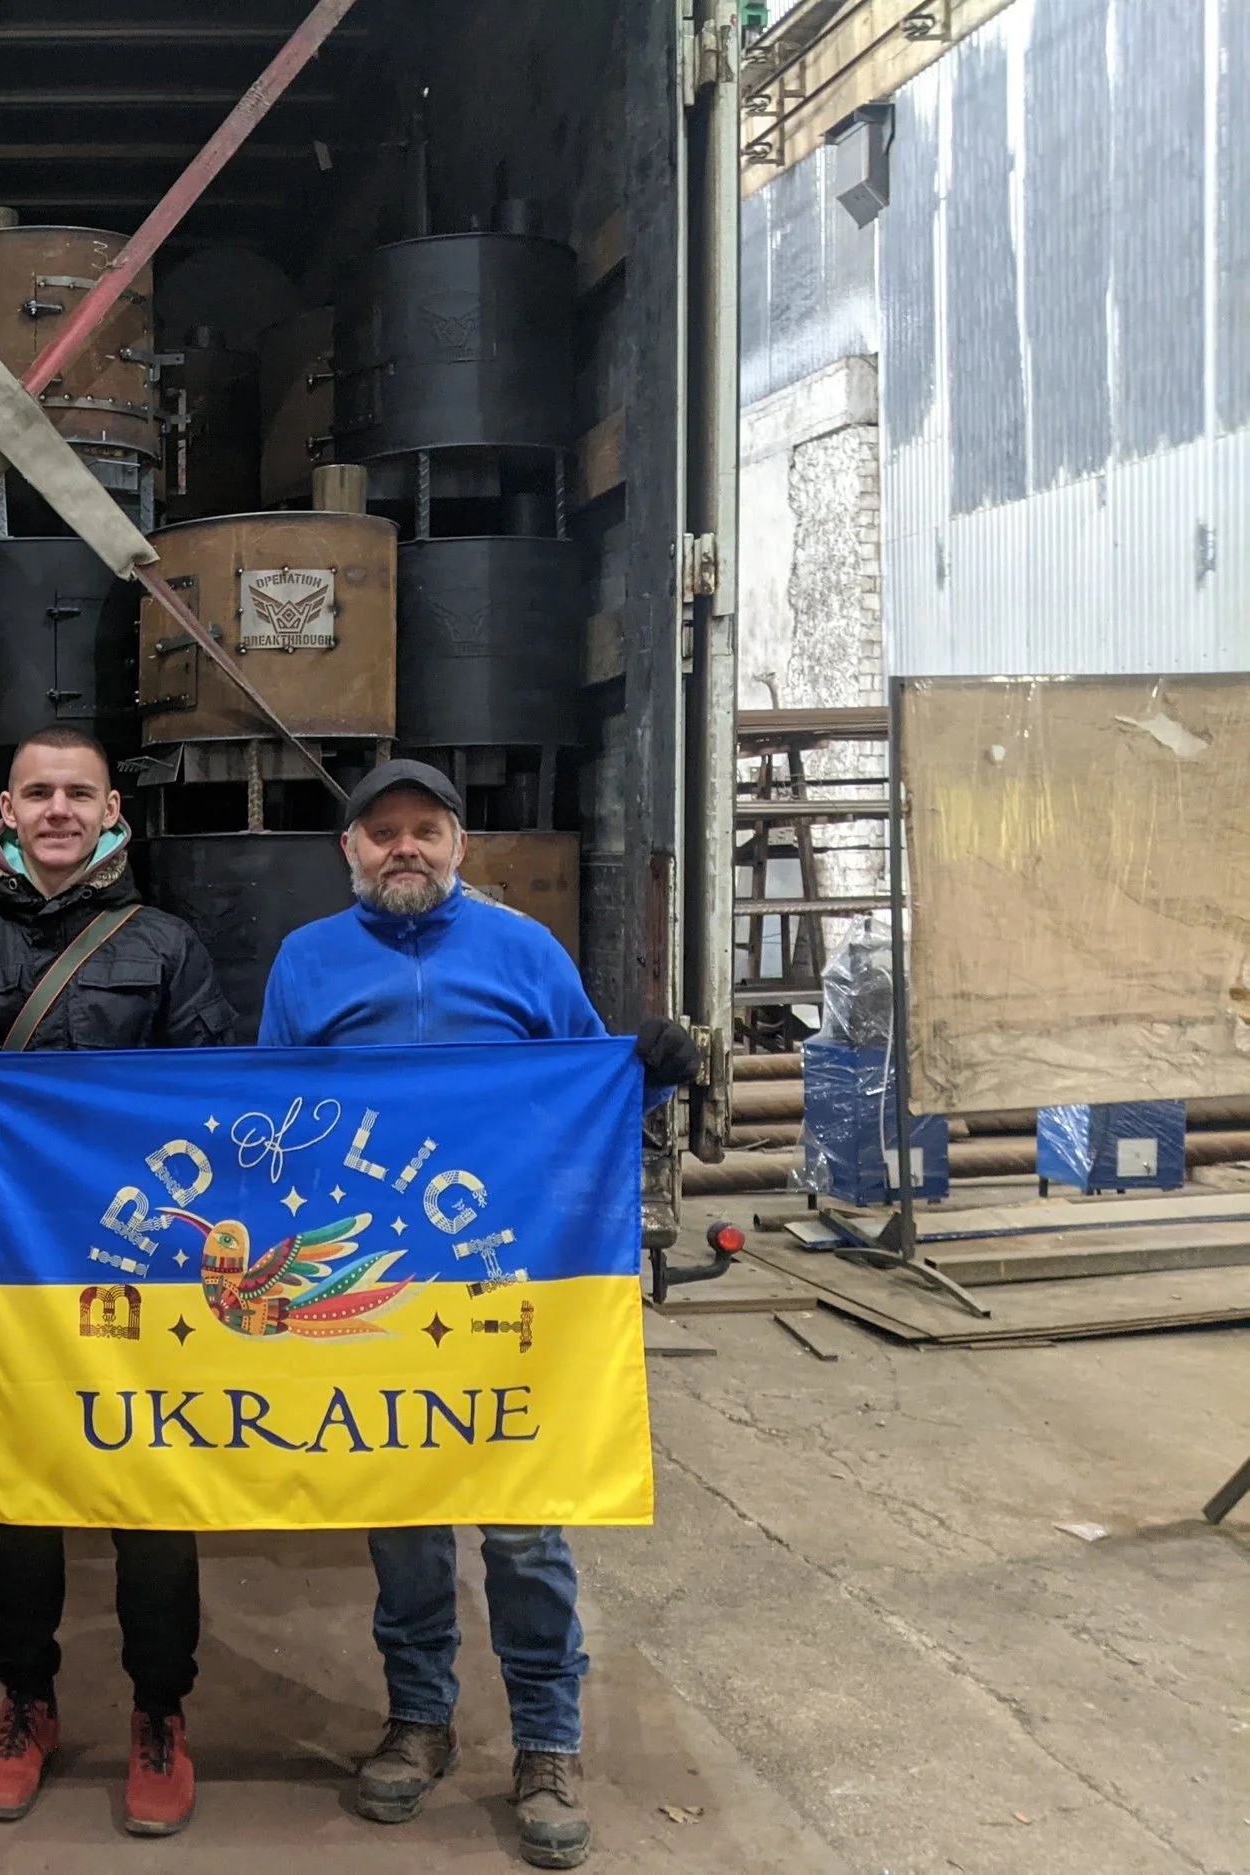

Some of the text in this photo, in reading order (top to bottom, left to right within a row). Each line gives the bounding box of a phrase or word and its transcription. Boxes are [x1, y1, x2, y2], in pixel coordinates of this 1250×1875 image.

[255, 573, 322, 589] OPERATION
[242, 634, 333, 647] BREAKTHROUGH
[79, 1138, 213, 1341] BIRD
[75, 1386, 540, 1453] UKRAINE
